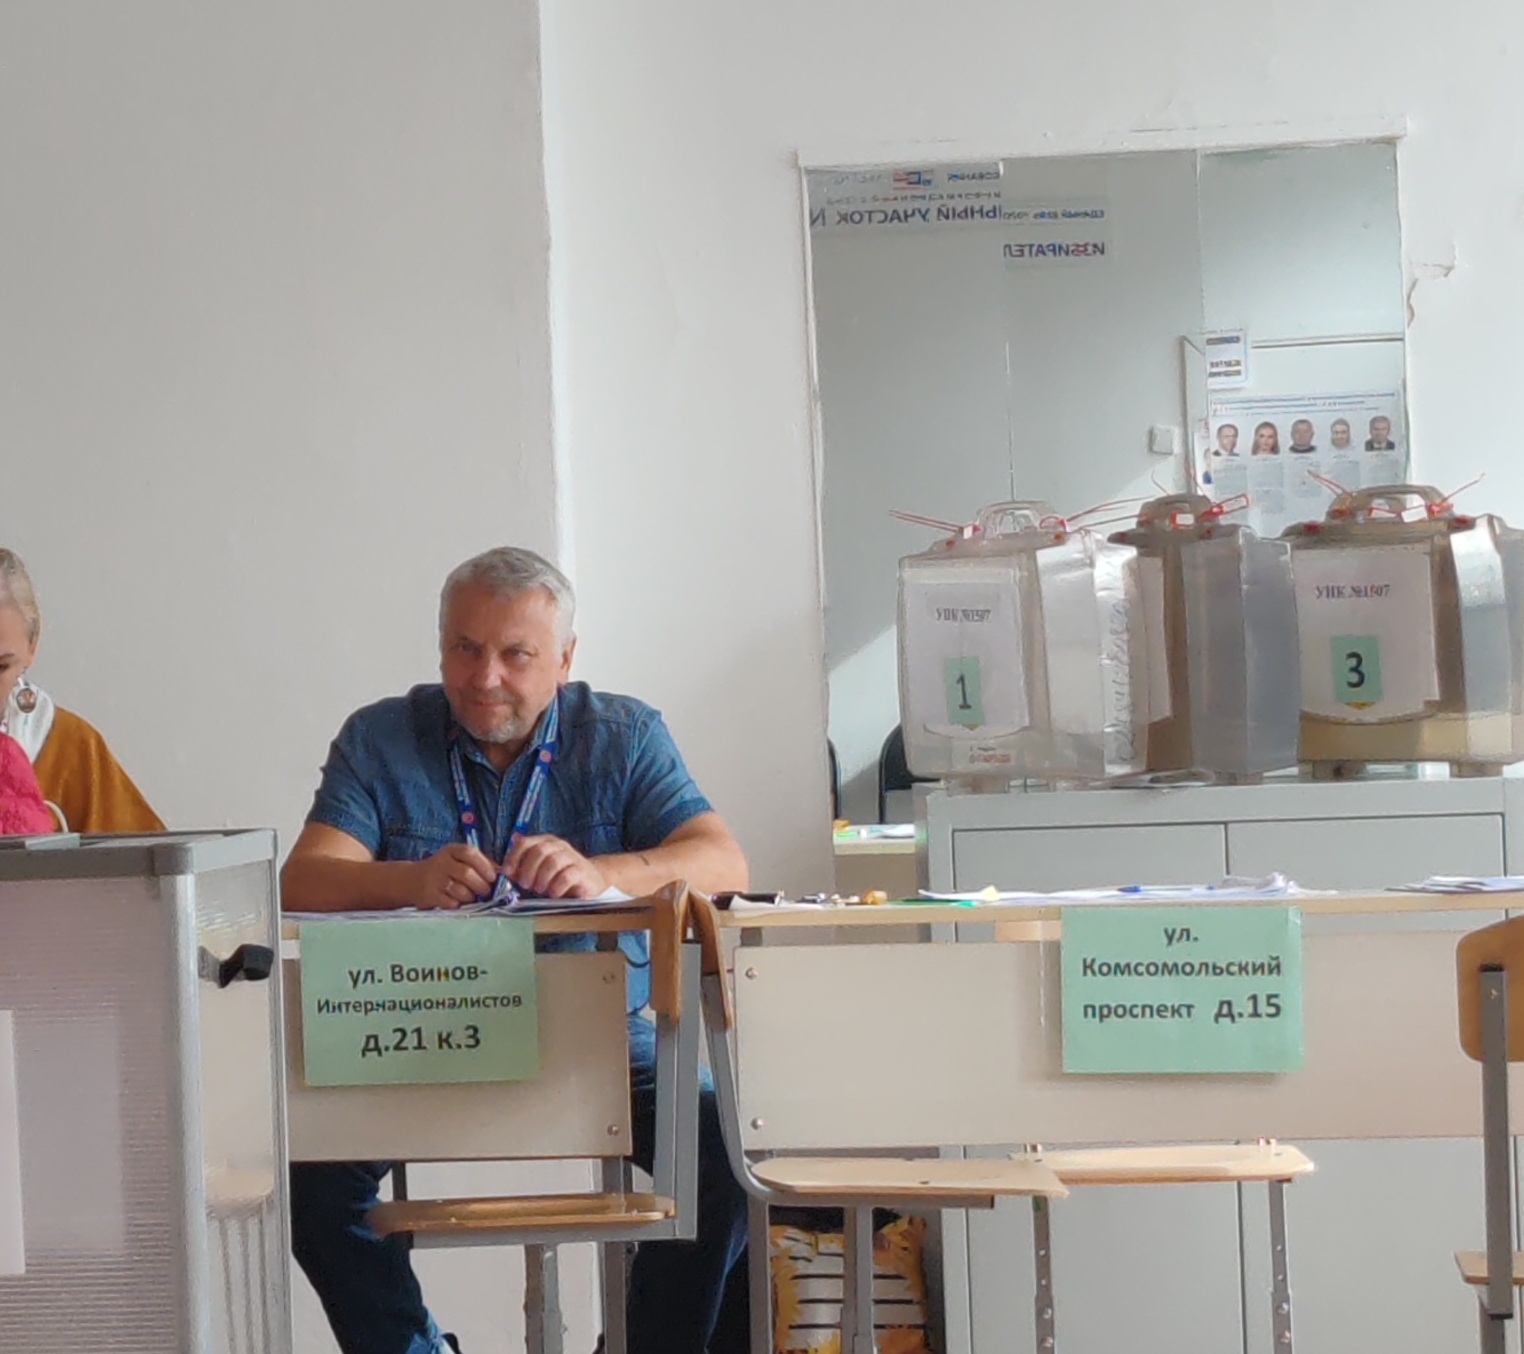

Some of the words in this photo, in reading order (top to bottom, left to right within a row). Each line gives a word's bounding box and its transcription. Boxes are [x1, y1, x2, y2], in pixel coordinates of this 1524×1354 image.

[1344, 651, 1365, 689] 3
[956, 673, 972, 710] 1
[1164, 926, 1199, 946] ул.
[348, 968, 383, 989] ул.
[390, 964, 489, 983] Воинов-
[1081, 955, 1282, 978] Комсомольский
[316, 995, 523, 1016] Интернационалистов
[1082, 1003, 1195, 1023] проспект
[1213, 993, 1282, 1024] д.15
[361, 1026, 427, 1058] д.21
[437, 1024, 482, 1051] к.3
